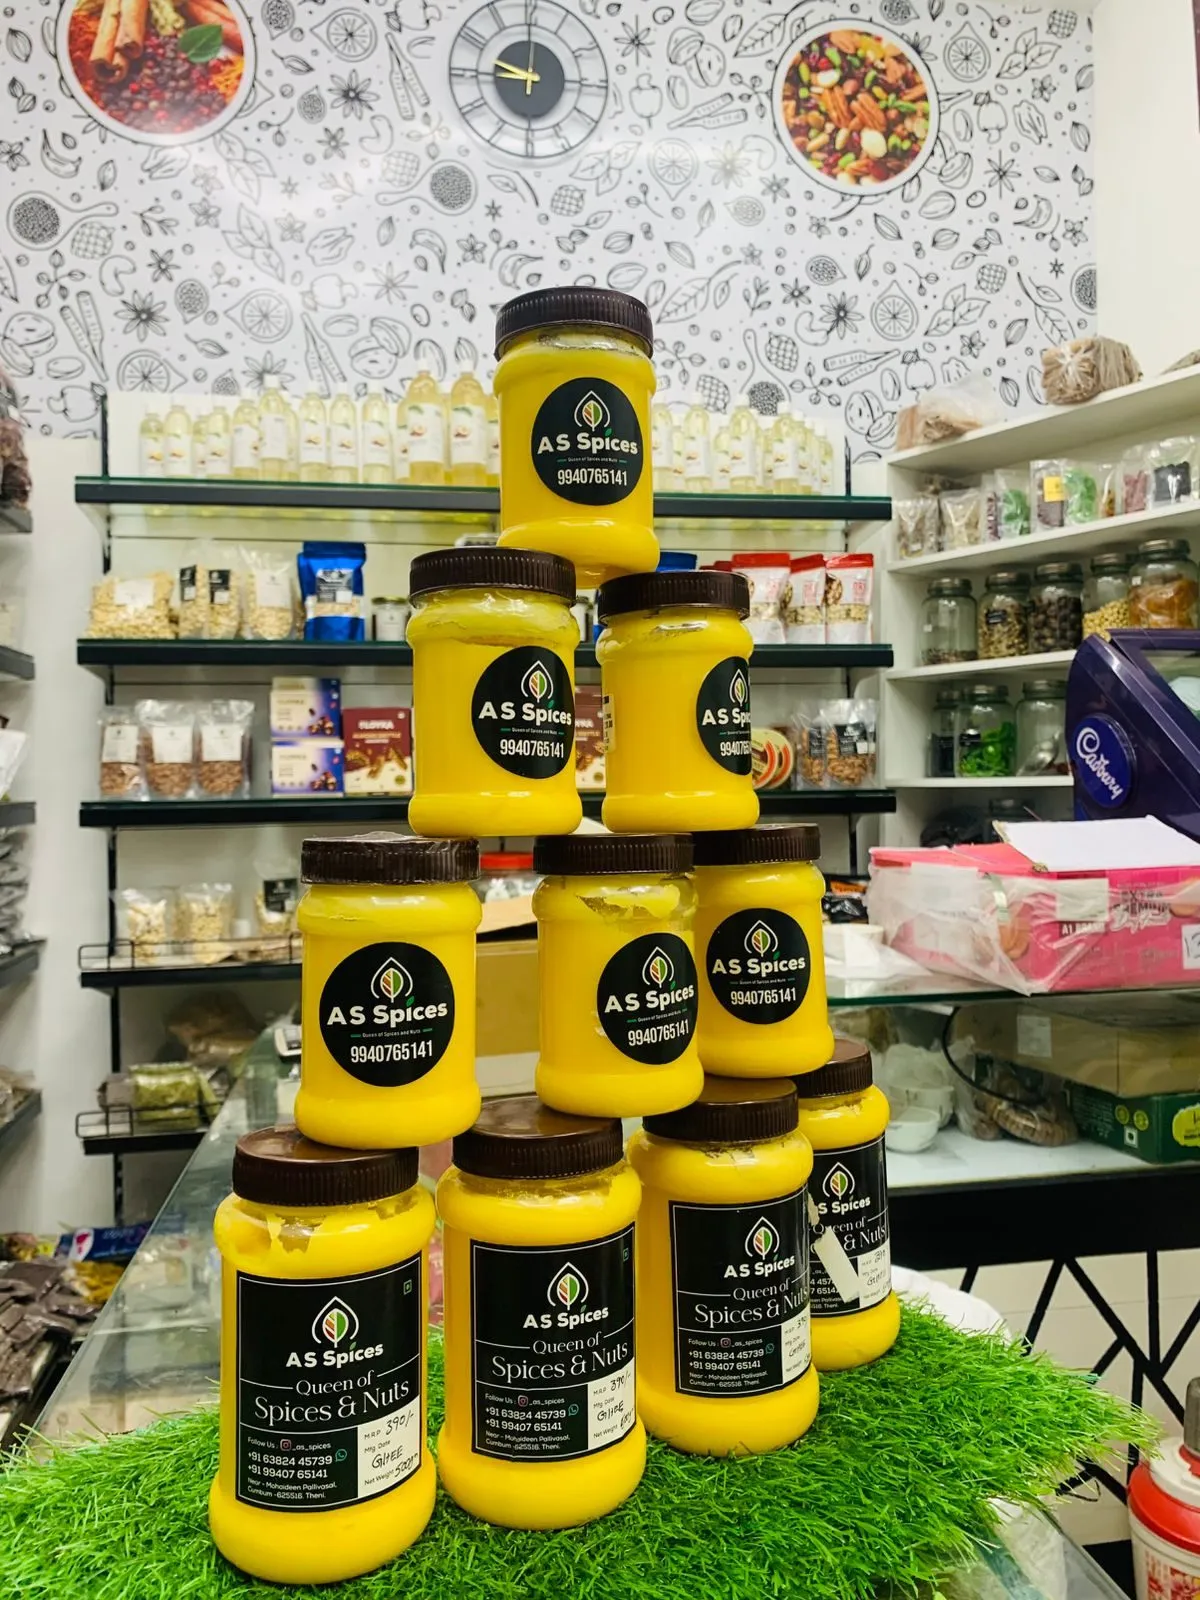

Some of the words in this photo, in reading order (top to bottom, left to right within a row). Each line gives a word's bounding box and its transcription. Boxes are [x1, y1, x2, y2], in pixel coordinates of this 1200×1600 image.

[577, 430, 638, 455] Spices
[557, 468, 627, 486] 9940765141
[522, 702, 572, 726] Spices
[500, 739, 564, 758] 9940765141
[1076, 727, 1123, 800] Cadbury
[747, 953, 806, 978] Spices
[646, 983, 695, 1011] Spices
[730, 987, 796, 1005] 9940765141
[373, 998, 448, 1028] Spices
[628, 1019, 689, 1046] 9940765141
[351, 1040, 432, 1063] 9940765141
[831, 1196, 871, 1215] Spices
[813, 1223, 853, 1235] Qeen
[855, 1216, 866, 1229] of
[860, 1225, 885, 1248] Nuts
[754, 1255, 795, 1277] Spices
[733, 1286, 777, 1301] Queen
[779, 1278, 790, 1292] of
[817, 1287, 839, 1295] 6514
[557, 1306, 609, 1330] Spices
[694, 1303, 763, 1329] Spices
[766, 1299, 780, 1318] &
[532, 1340, 584, 1355] Queen
[587, 1331, 602, 1347] of
[688, 1338, 707, 1346] Follow
[323, 1343, 384, 1369] Spices
[492, 1355, 566, 1384] Spices
[570, 1354, 587, 1376] &
[592, 1342, 628, 1371] Nuts
[689, 1350, 703, 1359] +91
[704, 1351, 735, 1360] 63824
[736, 1349, 765, 1359] 45739
[689, 1361, 703, 1370] +91
[705, 1362, 735, 1371] 99407
[736, 1360, 761, 1370] 65141
[296, 1379, 353, 1396] Queen
[357, 1370, 374, 1387] of
[254, 1396, 332, 1427] Spices
[337, 1395, 356, 1418] &
[362, 1380, 409, 1414] Nuts
[485, 1393, 504, 1402] Follow
[386, 1409, 414, 1435] 390/-
[486, 1407, 500, 1417] +91
[501, 1410, 533, 1420] 63824
[534, 1409, 567, 1419] 45739
[485, 1430, 500, 1439] Near
[486, 1419, 500, 1428] +91
[501, 1422, 531, 1432] 99407
[534, 1422, 563, 1432] 65141
[247, 1436, 266, 1448] Follow
[292, 1442, 332, 1452] _as_spices
[485, 1438, 511, 1449] Cumbum
[248, 1451, 262, 1462] +91
[263, 1455, 296, 1466] 63824
[298, 1455, 333, 1466] 45739
[371, 1445, 403, 1469] GHEE
[248, 1464, 262, 1475] +91
[263, 1468, 295, 1479] 99407
[297, 1469, 328, 1479] 65141
[247, 1477, 261, 1486] Near
[266, 1481, 302, 1491] Mohaideen
[247, 1486, 273, 1497] Cumbum
